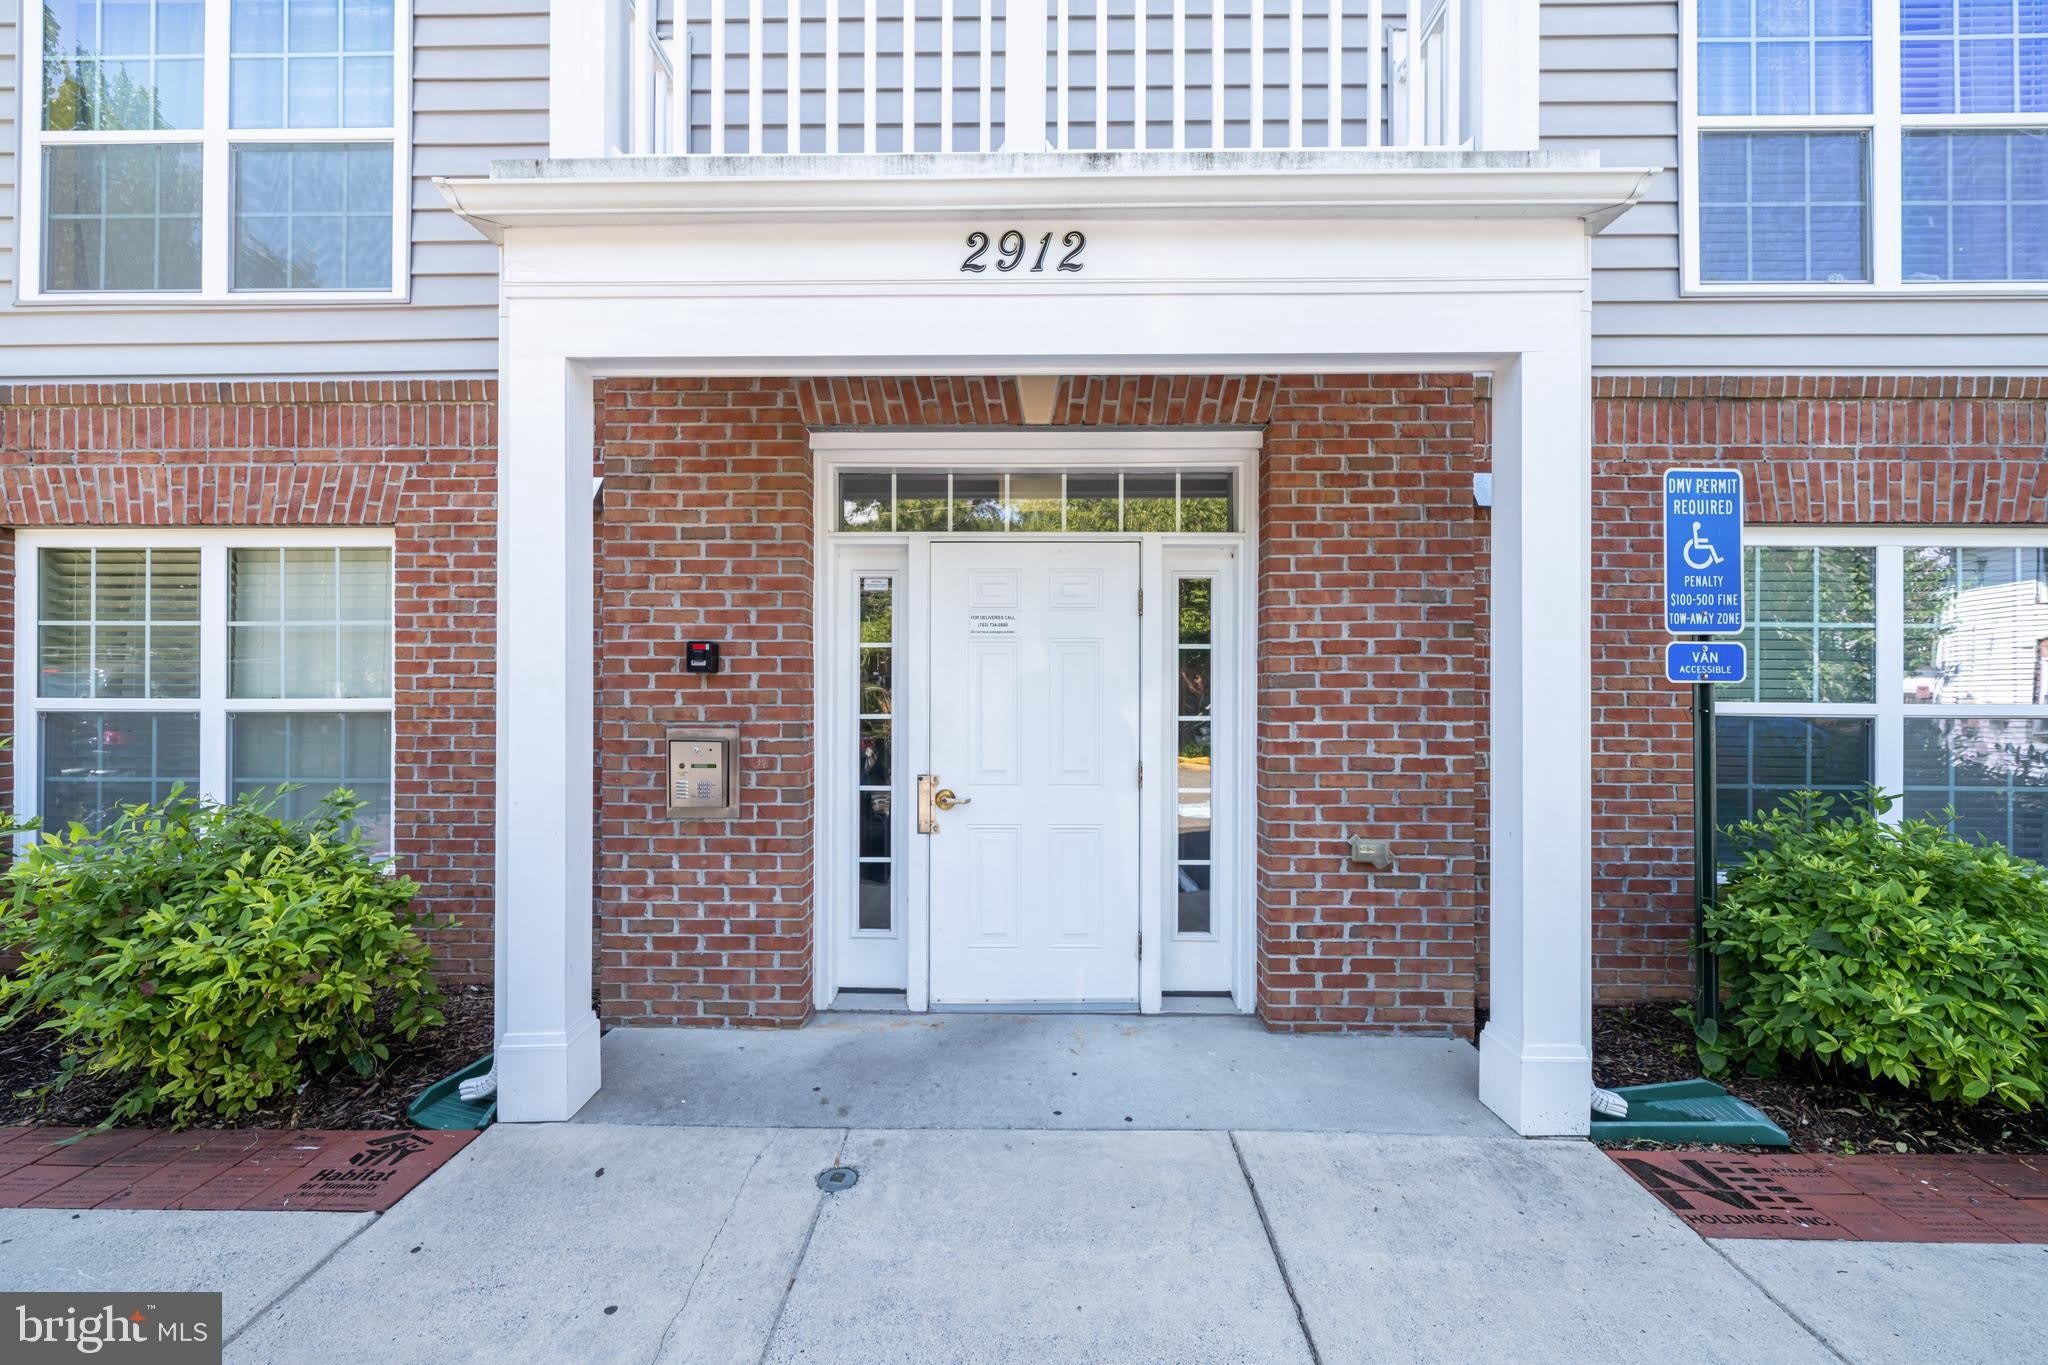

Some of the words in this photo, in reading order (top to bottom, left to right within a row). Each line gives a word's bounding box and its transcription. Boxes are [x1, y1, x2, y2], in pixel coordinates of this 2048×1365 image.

[960, 230, 1086, 272] 2912
[1669, 478, 1692, 494] DMV
[1696, 478, 1737, 494] PERMIT
[1673, 500, 1733, 515] REQUIRED
[1684, 575, 1724, 587] PENALTY
[1670, 593, 1714, 606] $100-500
[1718, 593, 1738, 606] FINE
[1669, 612, 1714, 625] TOW-AWAY
[1717, 612, 1740, 625] ZONE
[1692, 652, 1719, 664] VAN
[1679, 665, 1732, 674] ACCESSIBLE
[309, 1168, 397, 1181] Habitat
[297, 1182, 318, 1190] for
[320, 1182, 379, 1191] Humanity
